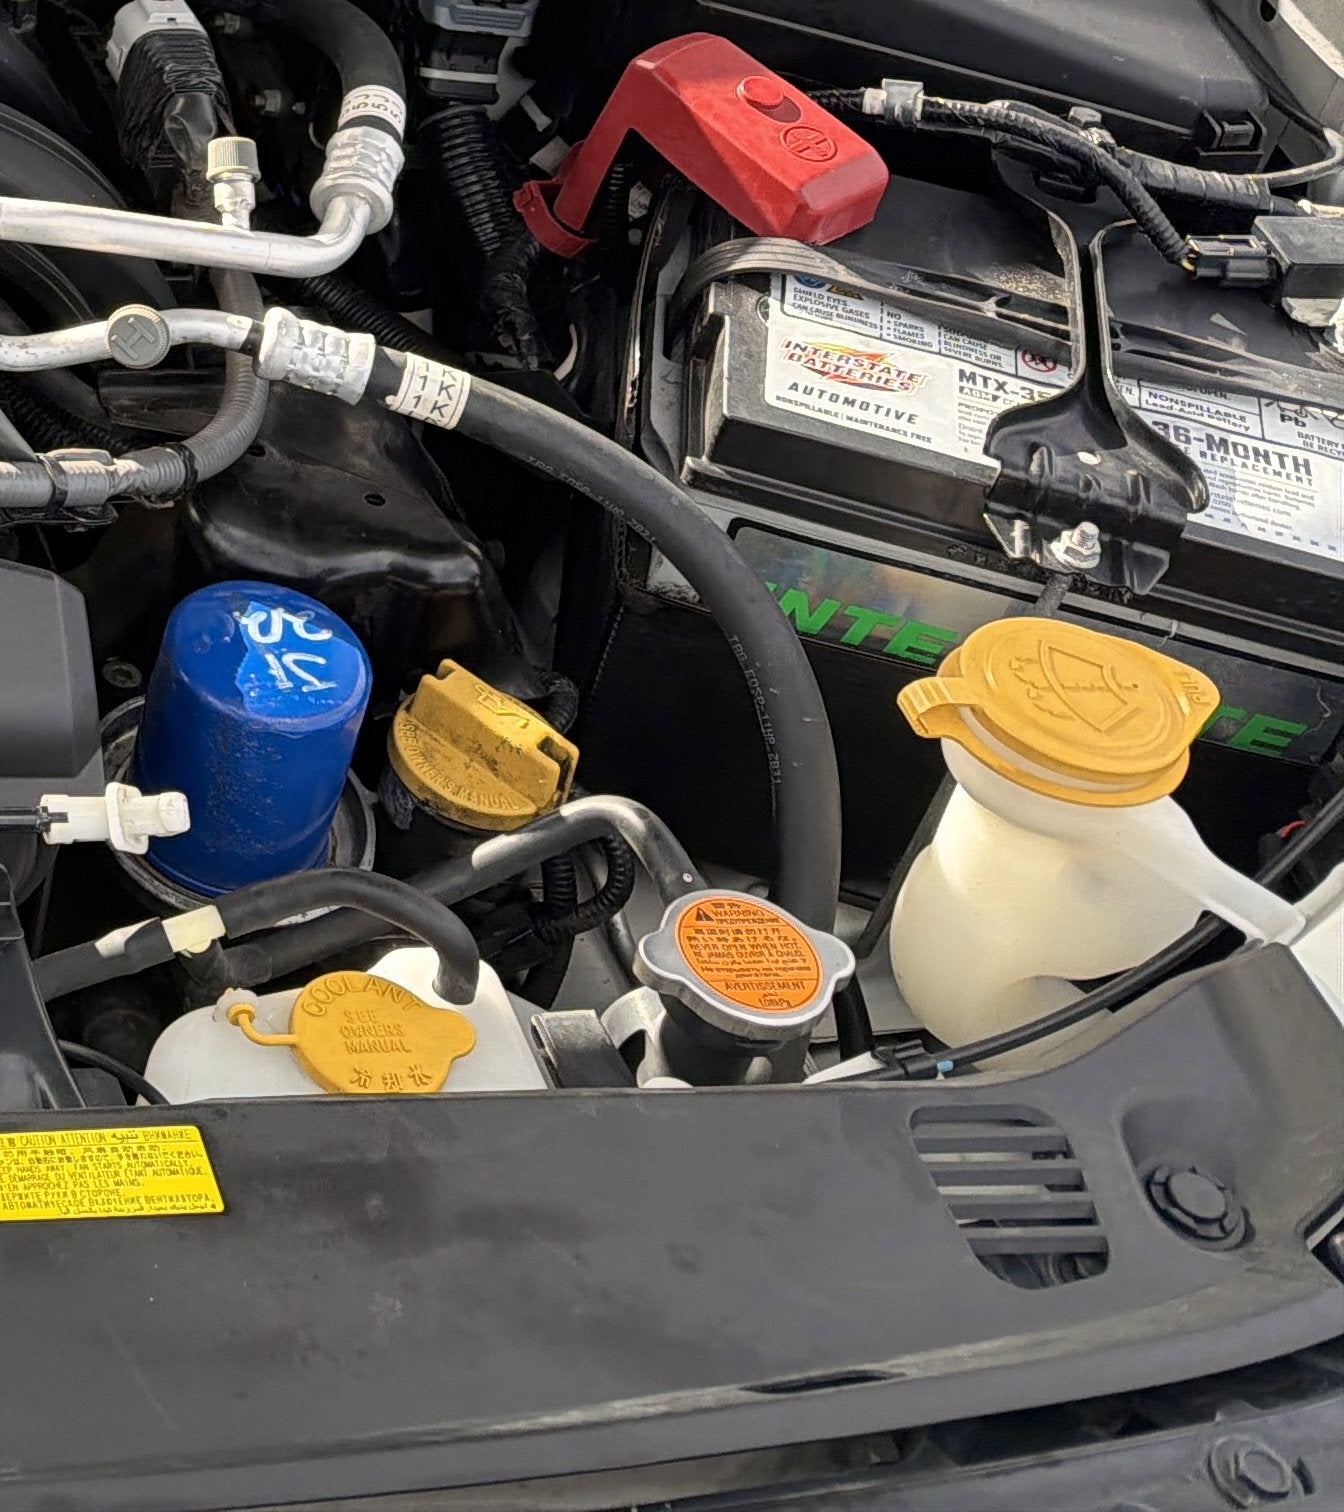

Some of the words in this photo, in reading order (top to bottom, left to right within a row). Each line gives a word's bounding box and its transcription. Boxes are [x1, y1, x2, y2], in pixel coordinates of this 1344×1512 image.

[793, 293, 840, 311] EXPLOSIVE
[841, 306, 870, 320] GASES
[886, 310, 902, 321] NO
[111, 316, 156, 361] H
[784, 340, 924, 385] INTERSTATE
[789, 352, 913, 391] BATTERIES
[787, 382, 919, 425] AUTOMOTIVE
[1147, 390, 1248, 424] NONSPILLABLE
[1279, 412, 1307, 428] Pb
[1150, 420, 1313, 477] 36-MONTH
[1200, 450, 1314, 486] REPLACEMENT
[456, 786, 521, 811] MANUAL
[712, 909, 766, 918] WARNING
[302, 974, 422, 1018] COOLANT
[724, 981, 806, 992] AVERTISSEMENT
[343, 1009, 380, 1024] SEE
[339, 1023, 405, 1039] OWNERS
[345, 1038, 413, 1055] MANUAL
[19, 1134, 57, 1147] CAUTION
[60, 1132, 107, 1146] ATTENTION
